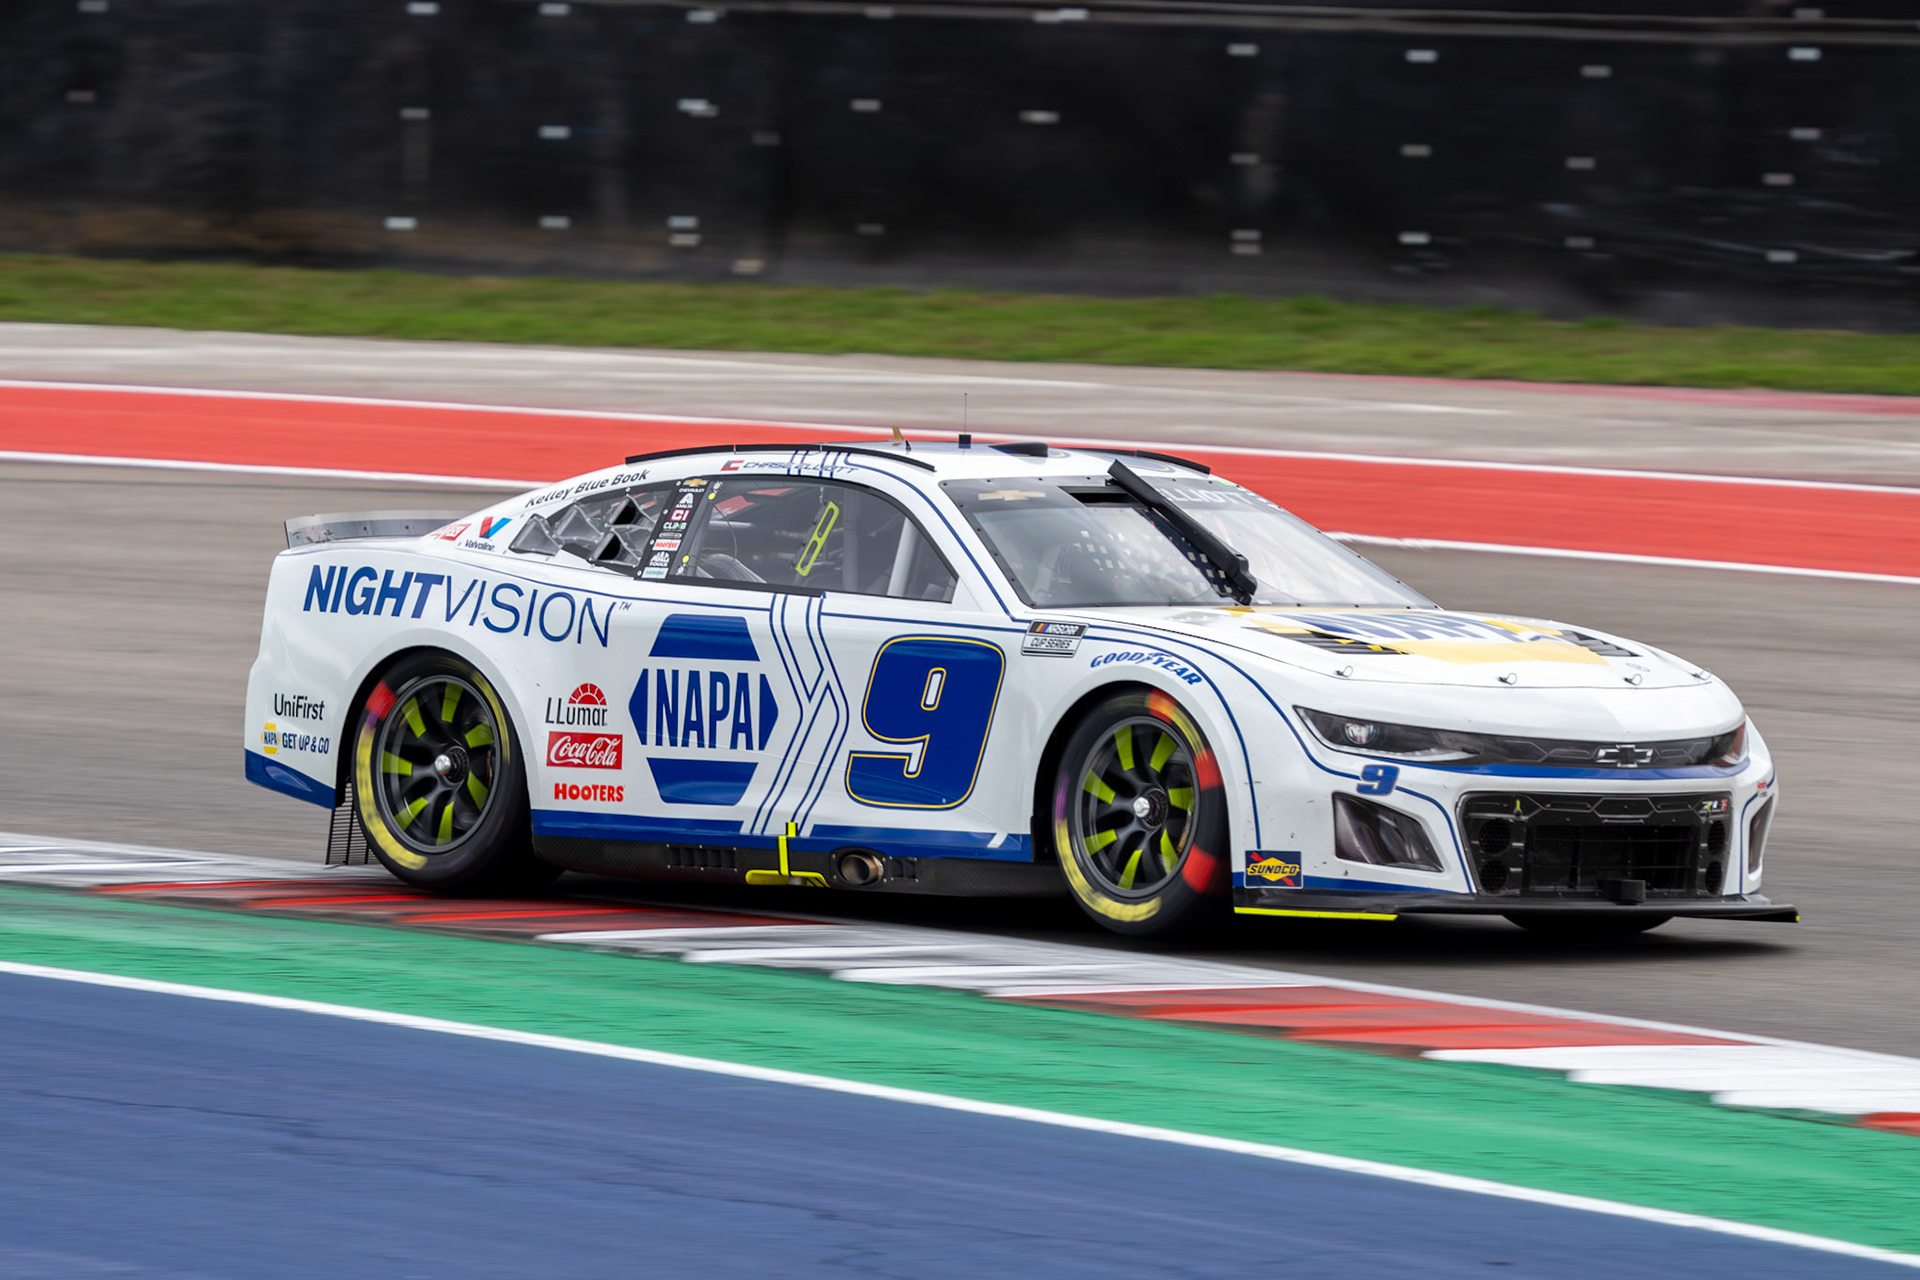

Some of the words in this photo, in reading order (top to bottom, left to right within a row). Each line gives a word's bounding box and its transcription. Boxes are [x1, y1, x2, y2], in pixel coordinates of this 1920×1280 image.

[743, 461, 791, 469] CHASE
[525, 486, 574, 508] Kelley
[574, 479, 609, 494] Blue
[611, 469, 650, 486] Book
[465, 540, 495, 551] Valvoline
[303, 564, 617, 648] NIGHTVISION
[1046, 624, 1079, 635] NASCAR
[1030, 637, 1047, 647] CUP
[1045, 638, 1072, 648] SERIES
[1090, 651, 1203, 686] GOODYEAR
[274, 693, 325, 720] UniFirst
[545, 697, 608, 726] LLumar
[655, 668, 754, 751] NAPA
[845, 634, 1006, 811] 9
[263, 731, 278, 746] NAPA
[282, 732, 297, 750] GET
[299, 734, 311, 751] UP
[310, 736, 317, 752] &
[318, 737, 330, 754] GO
[1356, 764, 1400, 796] 9
[554, 783, 624, 802] HOOTERS
[1249, 865, 1298, 875] SUNOCO
